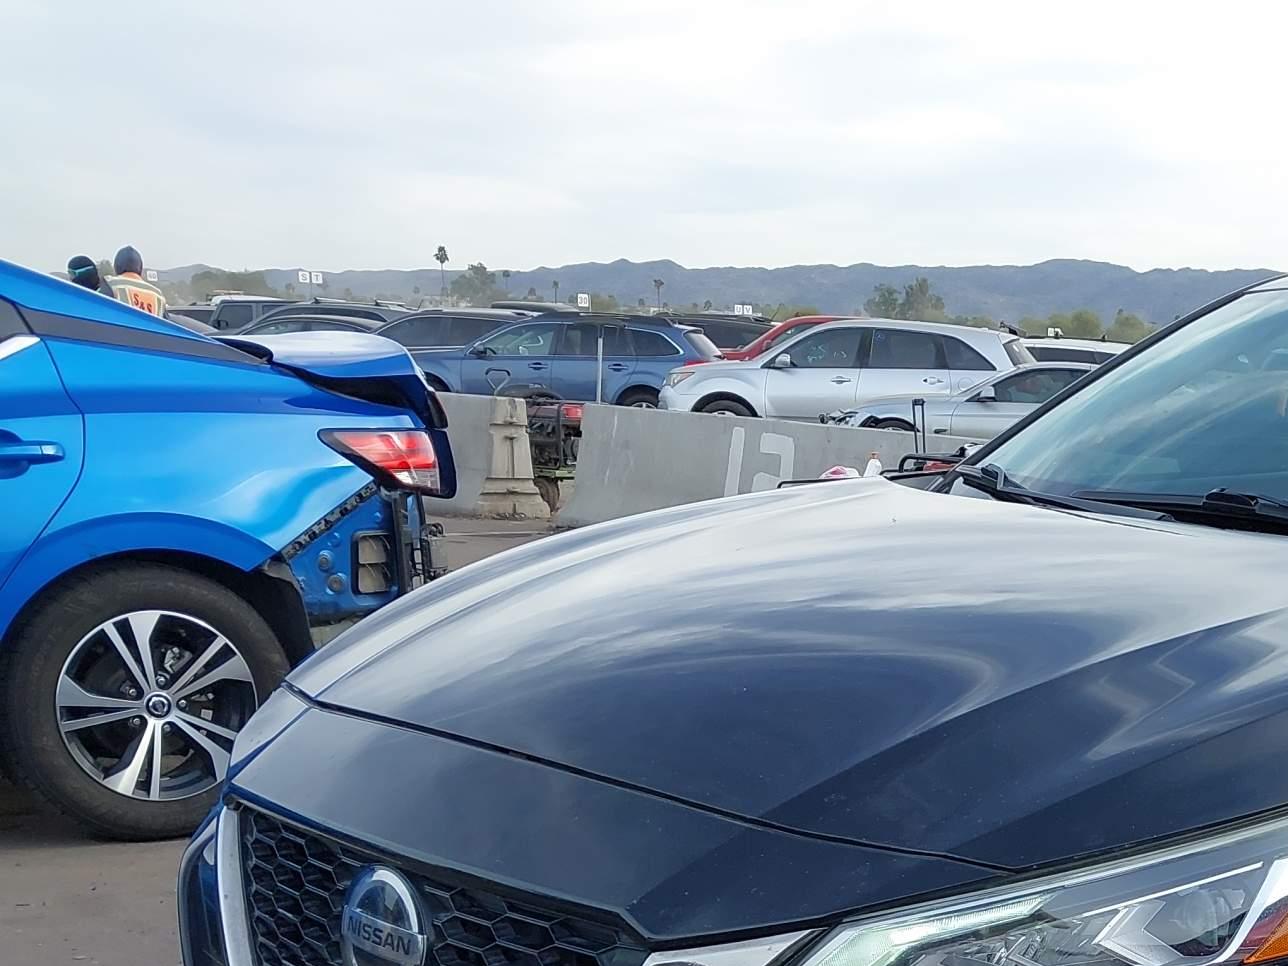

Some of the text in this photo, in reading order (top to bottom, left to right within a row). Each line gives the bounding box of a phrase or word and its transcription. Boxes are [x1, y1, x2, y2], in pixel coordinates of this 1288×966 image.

[301, 273, 308, 281] S
[578, 296, 588, 305] 30
[349, 915, 412, 955] NISSAN
